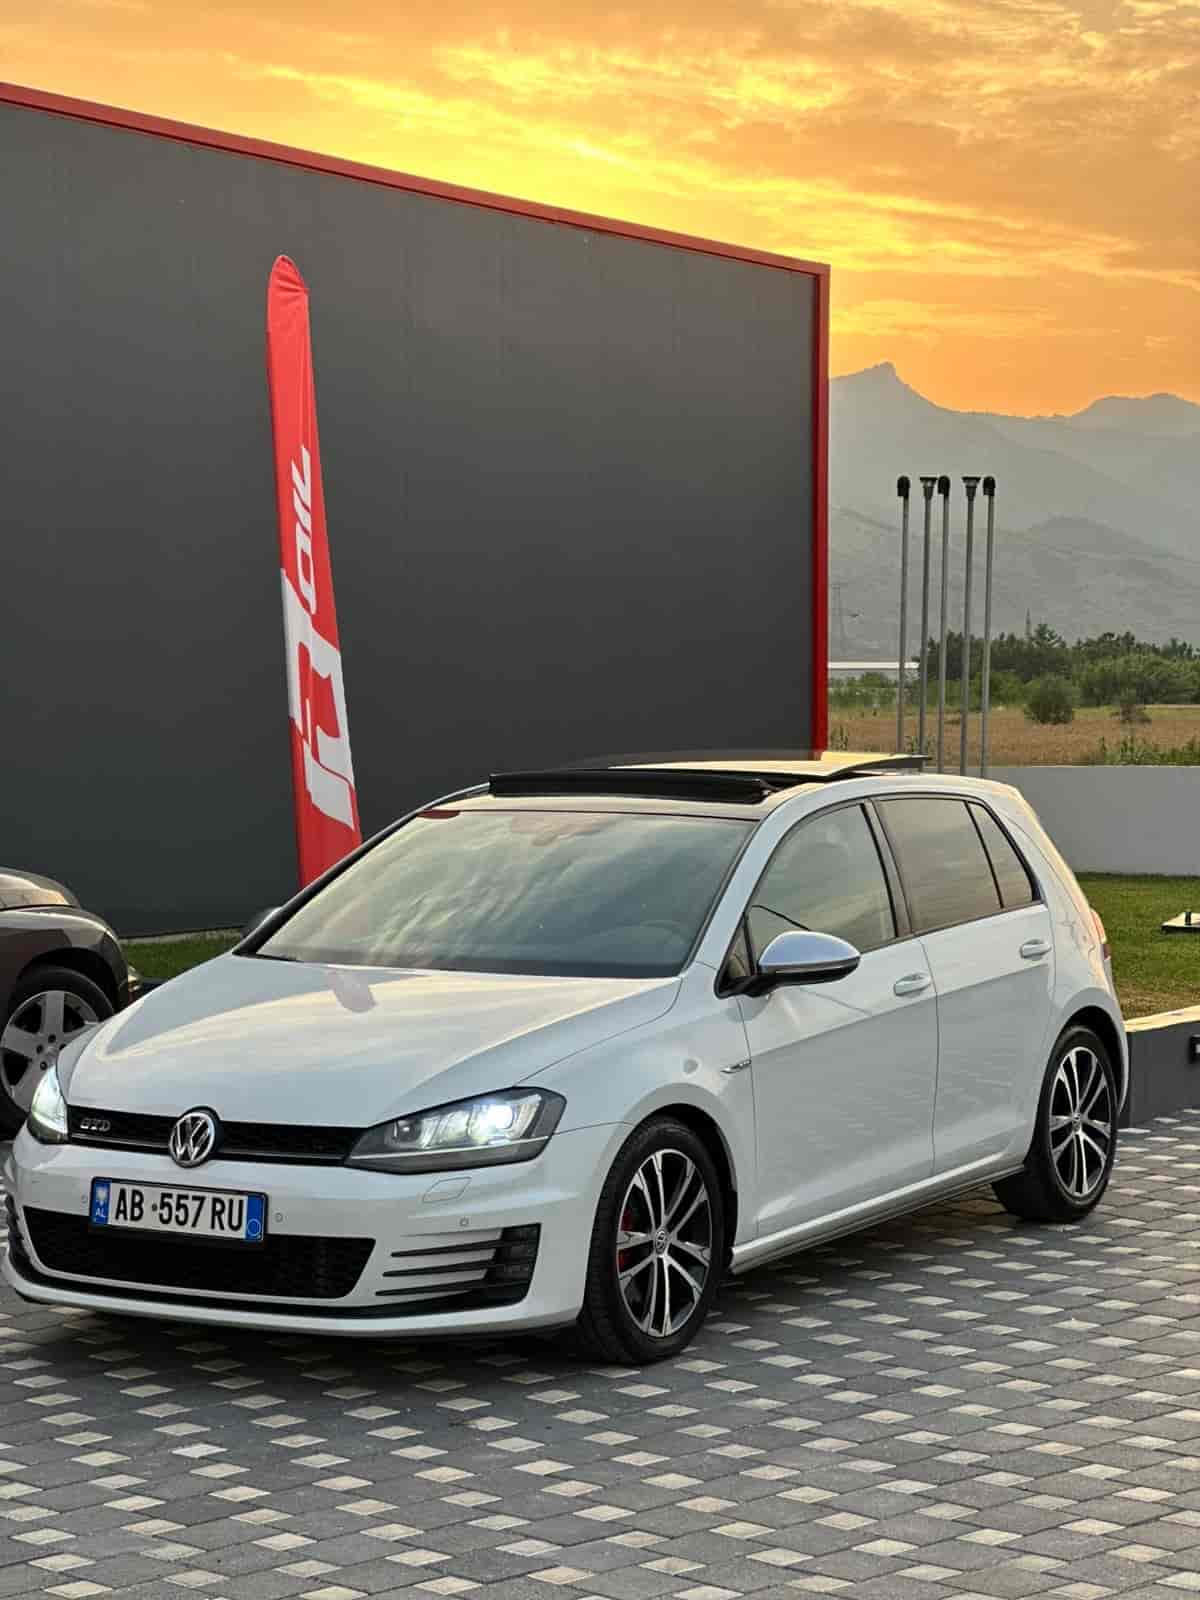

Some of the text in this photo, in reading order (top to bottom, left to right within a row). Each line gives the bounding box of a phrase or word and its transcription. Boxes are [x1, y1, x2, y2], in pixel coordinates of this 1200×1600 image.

[291, 445, 317, 615] OIL
[115, 1188, 244, 1232] AB 557 RU
